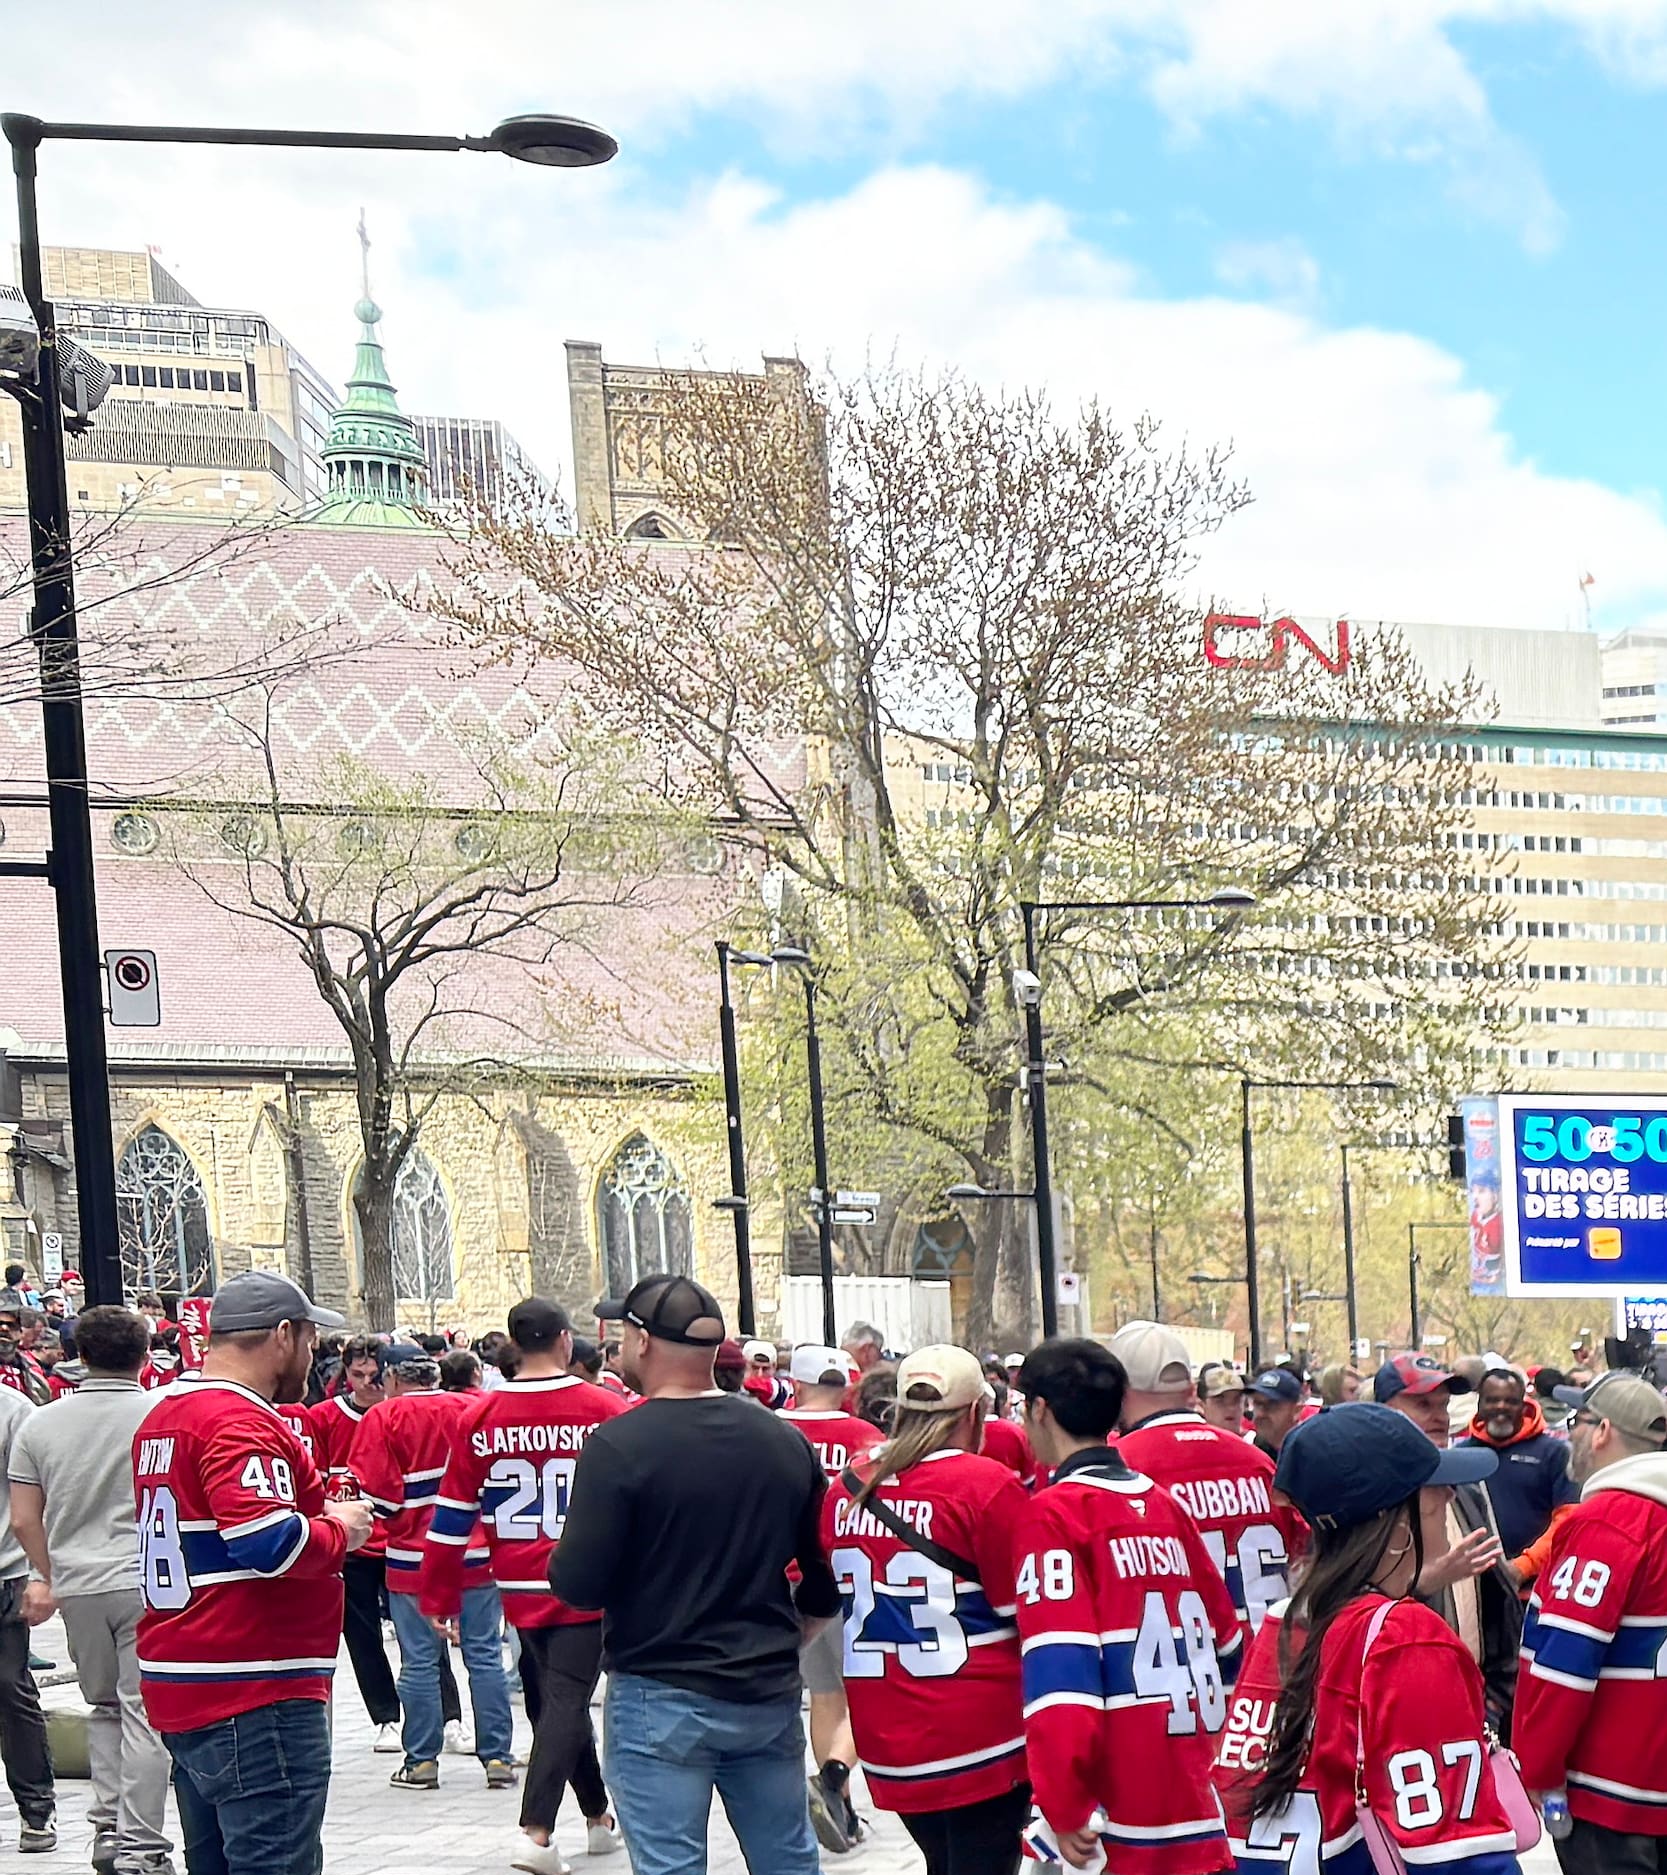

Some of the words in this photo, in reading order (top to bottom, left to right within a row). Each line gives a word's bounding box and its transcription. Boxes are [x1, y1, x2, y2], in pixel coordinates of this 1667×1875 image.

[1204, 614, 1350, 674] CN
[1522, 1168, 1630, 1193] TIRAGE
[1525, 1193, 1580, 1219] DES
[472, 1422, 600, 1456] SLAFKOVSK
[240, 1455, 295, 1502] 48
[490, 1458, 577, 1539] 20
[1170, 1476, 1271, 1520] SUBBAN
[1016, 1549, 1074, 1604] 48
[1109, 1536, 1190, 1579] HUTSON
[1551, 1556, 1611, 1608] 48
[831, 1547, 968, 1677] 23
[1132, 1591, 1227, 1734] 48
[1387, 1739, 1483, 1829] 87
